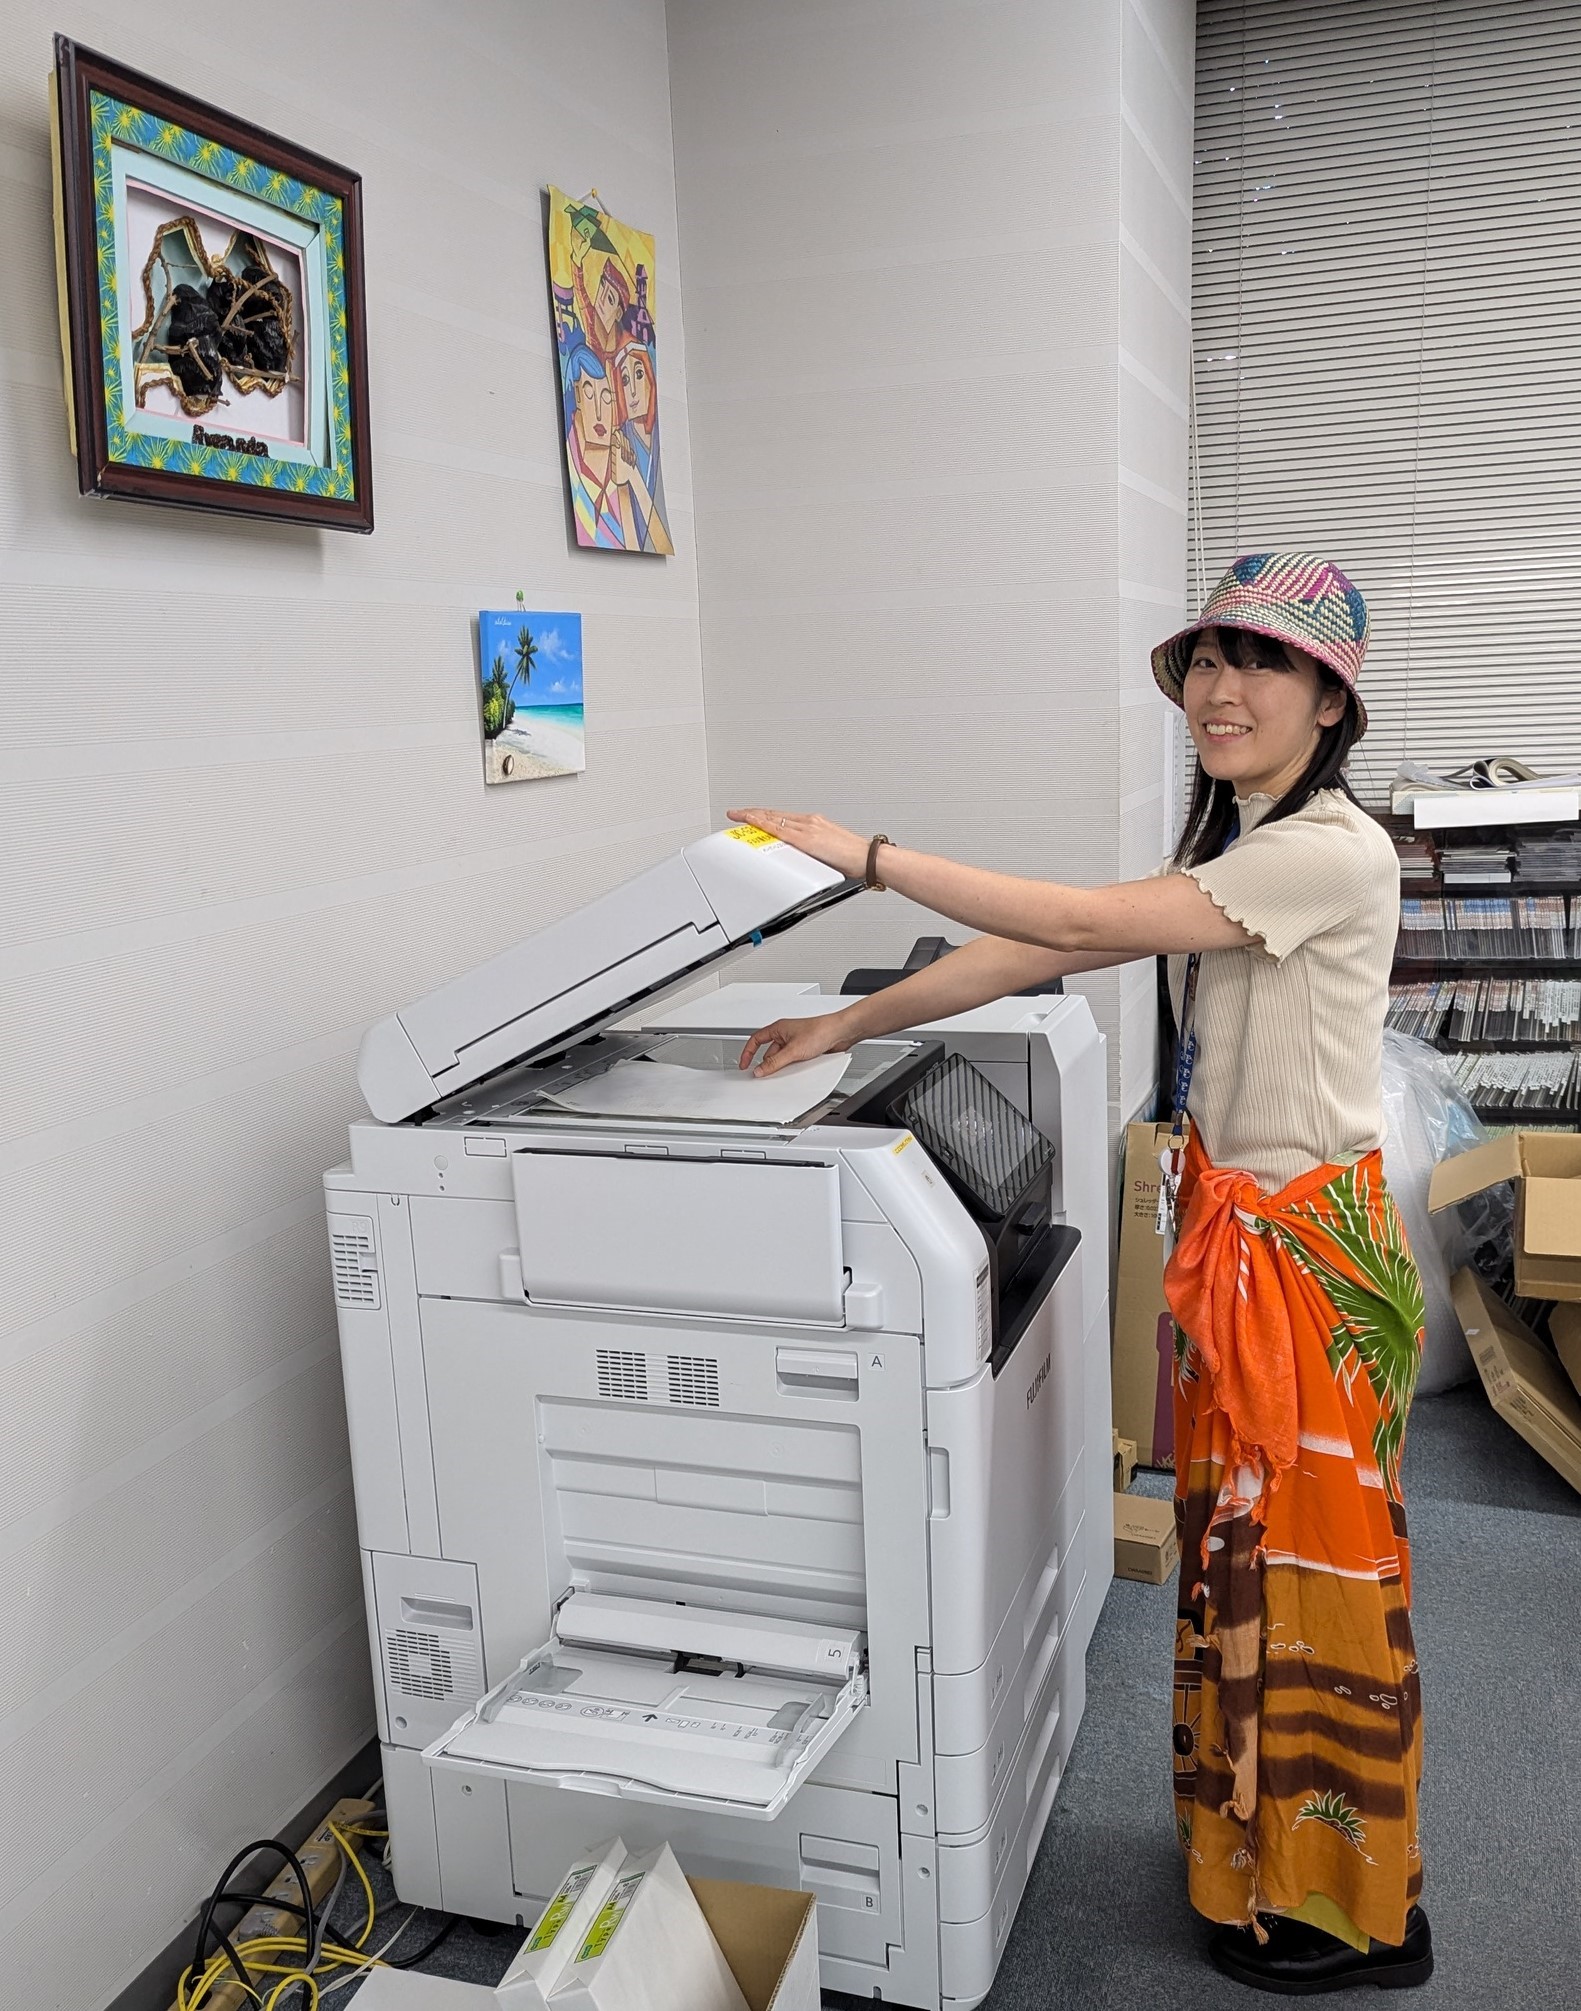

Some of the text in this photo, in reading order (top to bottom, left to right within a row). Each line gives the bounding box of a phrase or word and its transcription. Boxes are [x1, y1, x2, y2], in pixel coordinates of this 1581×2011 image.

[871, 1355, 883, 1368] A
[1026, 1352, 1051, 1410] FUJIFILM
[827, 1648, 841, 1658] 5
[865, 1896, 874, 1908] B
